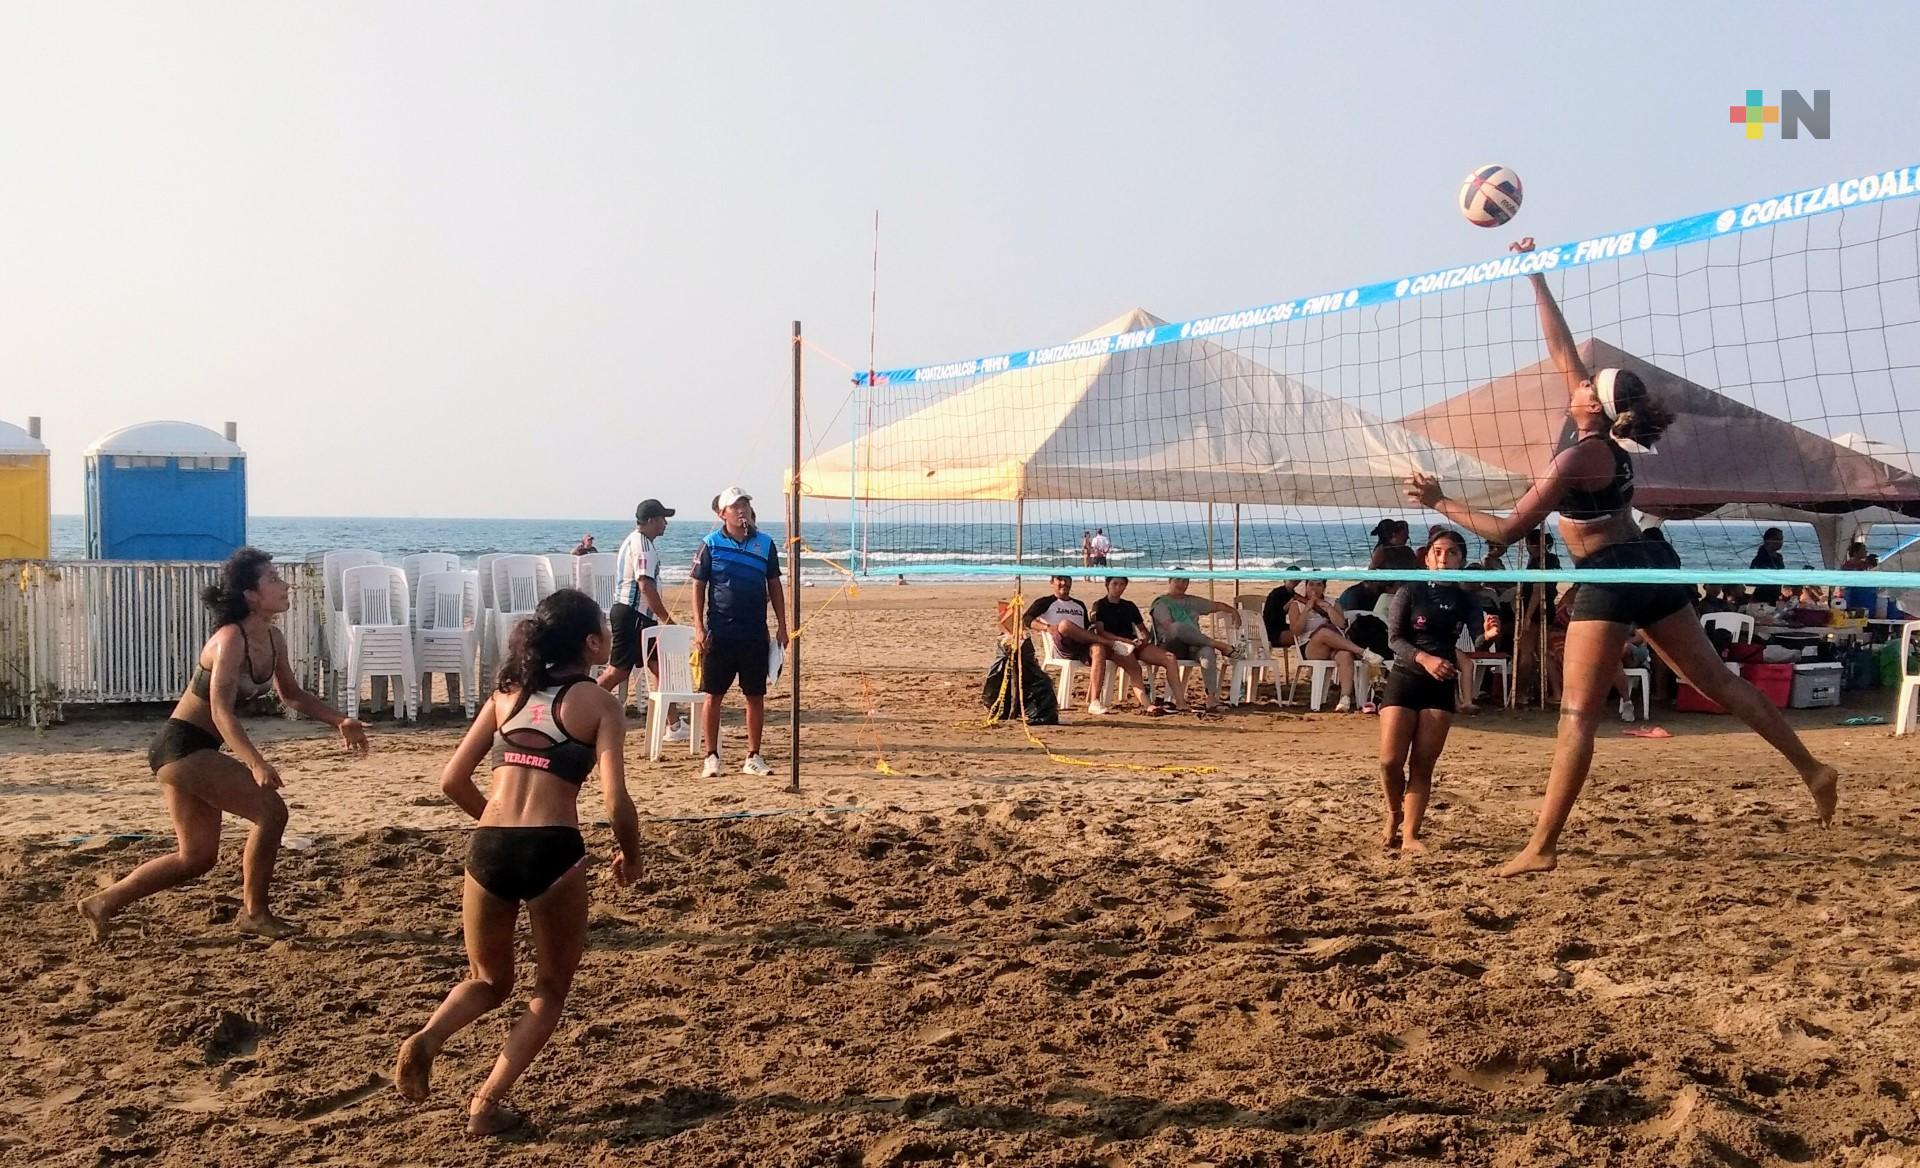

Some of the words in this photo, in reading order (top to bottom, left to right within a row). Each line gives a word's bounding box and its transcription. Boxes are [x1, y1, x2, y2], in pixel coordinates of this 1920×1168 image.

[1740, 167, 1920, 228] COATZACOAL
[1410, 246, 1562, 296] COATZACOALCOS
[1574, 231, 1636, 264] FMVB
[1190, 302, 1294, 338] COATZACOALCOS
[1301, 292, 1343, 317] FMVB
[504, 751, 551, 769] VERACRUZ
